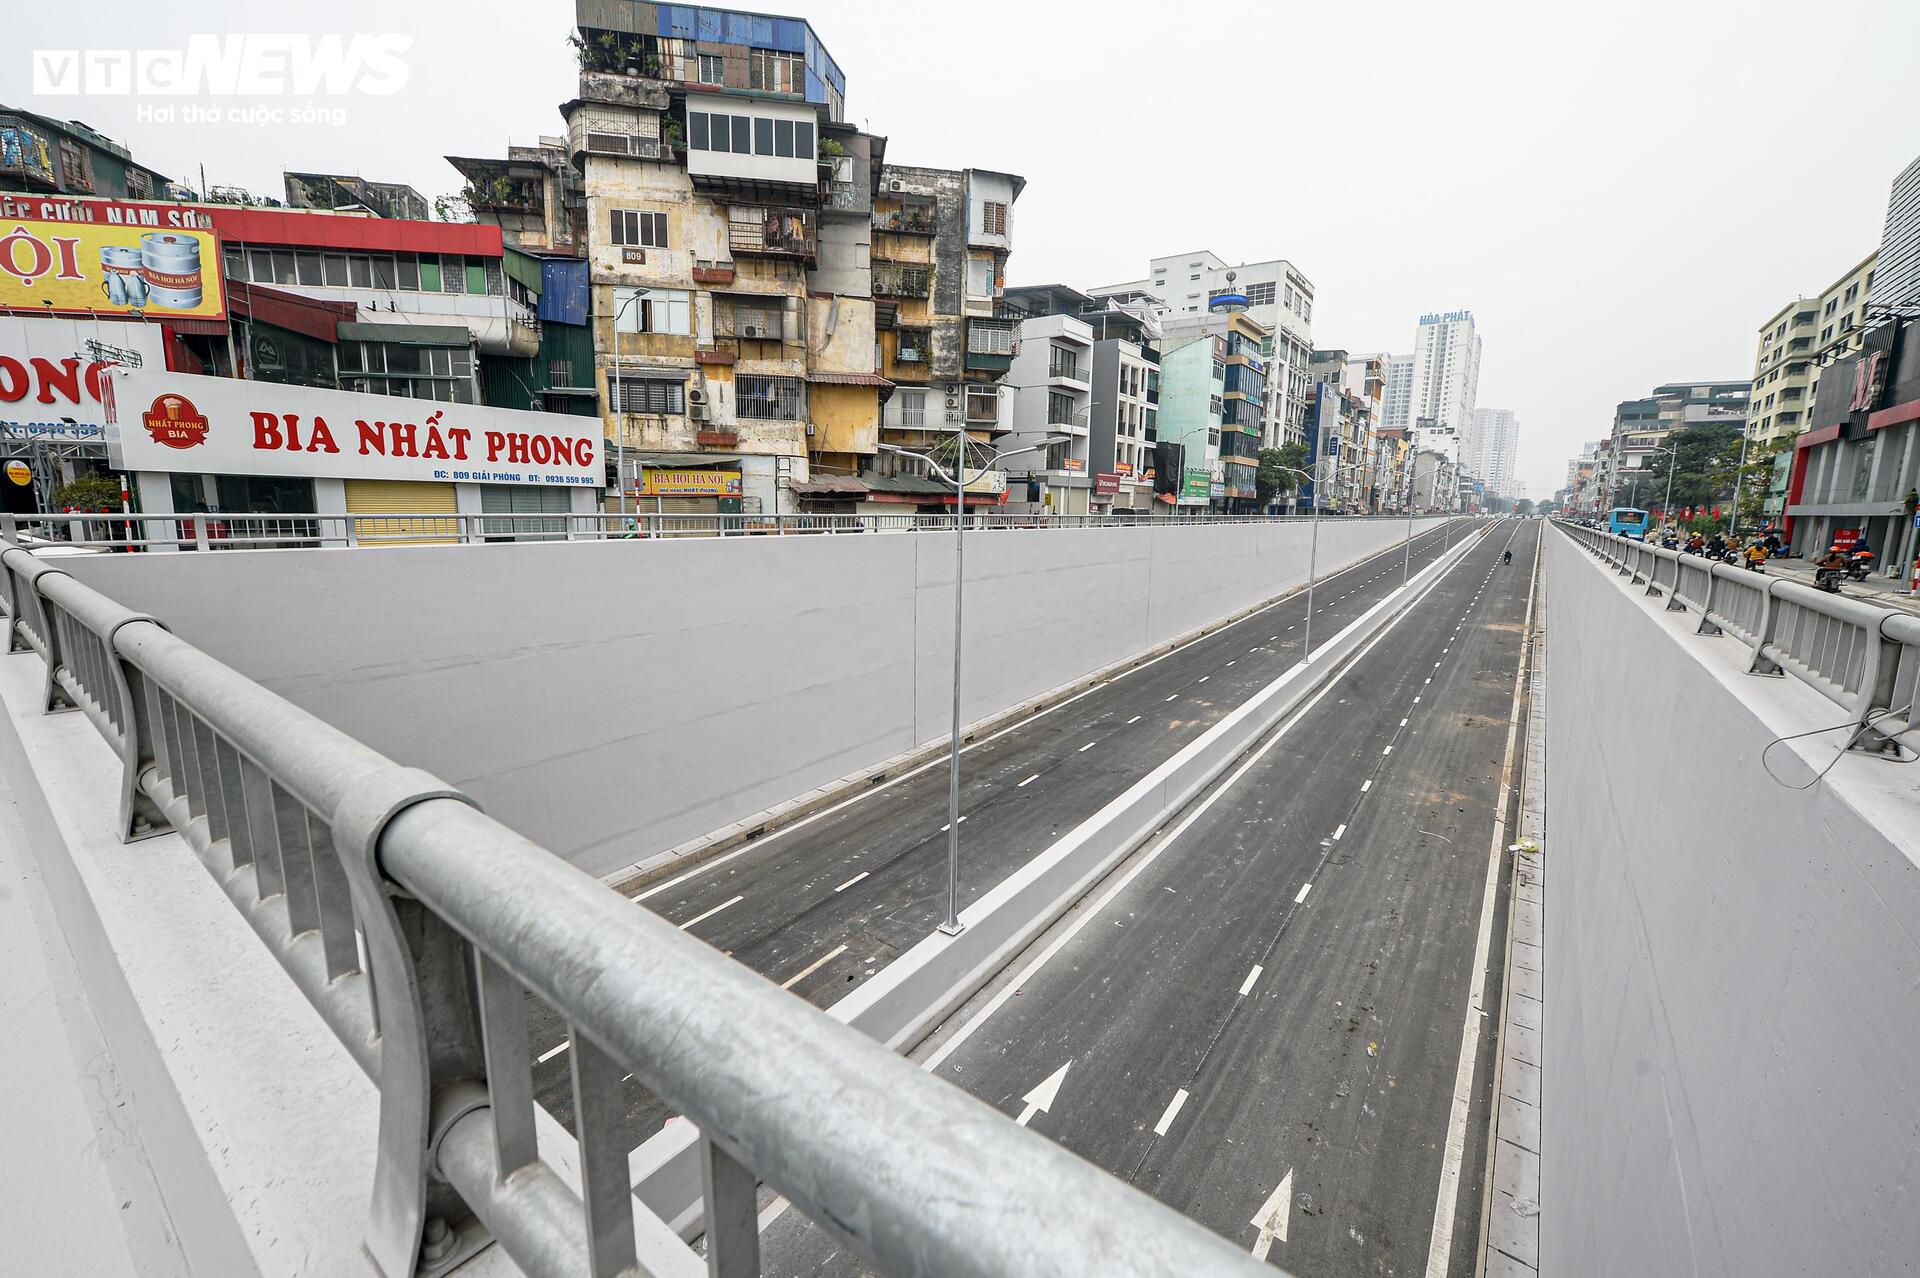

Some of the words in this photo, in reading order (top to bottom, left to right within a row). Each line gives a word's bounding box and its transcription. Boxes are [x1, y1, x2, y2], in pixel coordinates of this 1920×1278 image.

[106, 207, 159, 225] NAM
[626, 252, 641, 260] 809
[174, 421, 204, 430] PHONG
[168, 430, 189, 439] BIA
[249, 411, 341, 454] BIA
[354, 410, 472, 460] NHẤT
[485, 431, 594, 467] PHONG
[434, 470, 449, 479] ĐC:
[453, 471, 469, 480] 809
[528, 474, 540, 482] ĐT:
[545, 475, 563, 483] 0936
[566, 475, 579, 484] 559
[580, 476, 594, 484] 995
[654, 473, 670, 484] BIA
